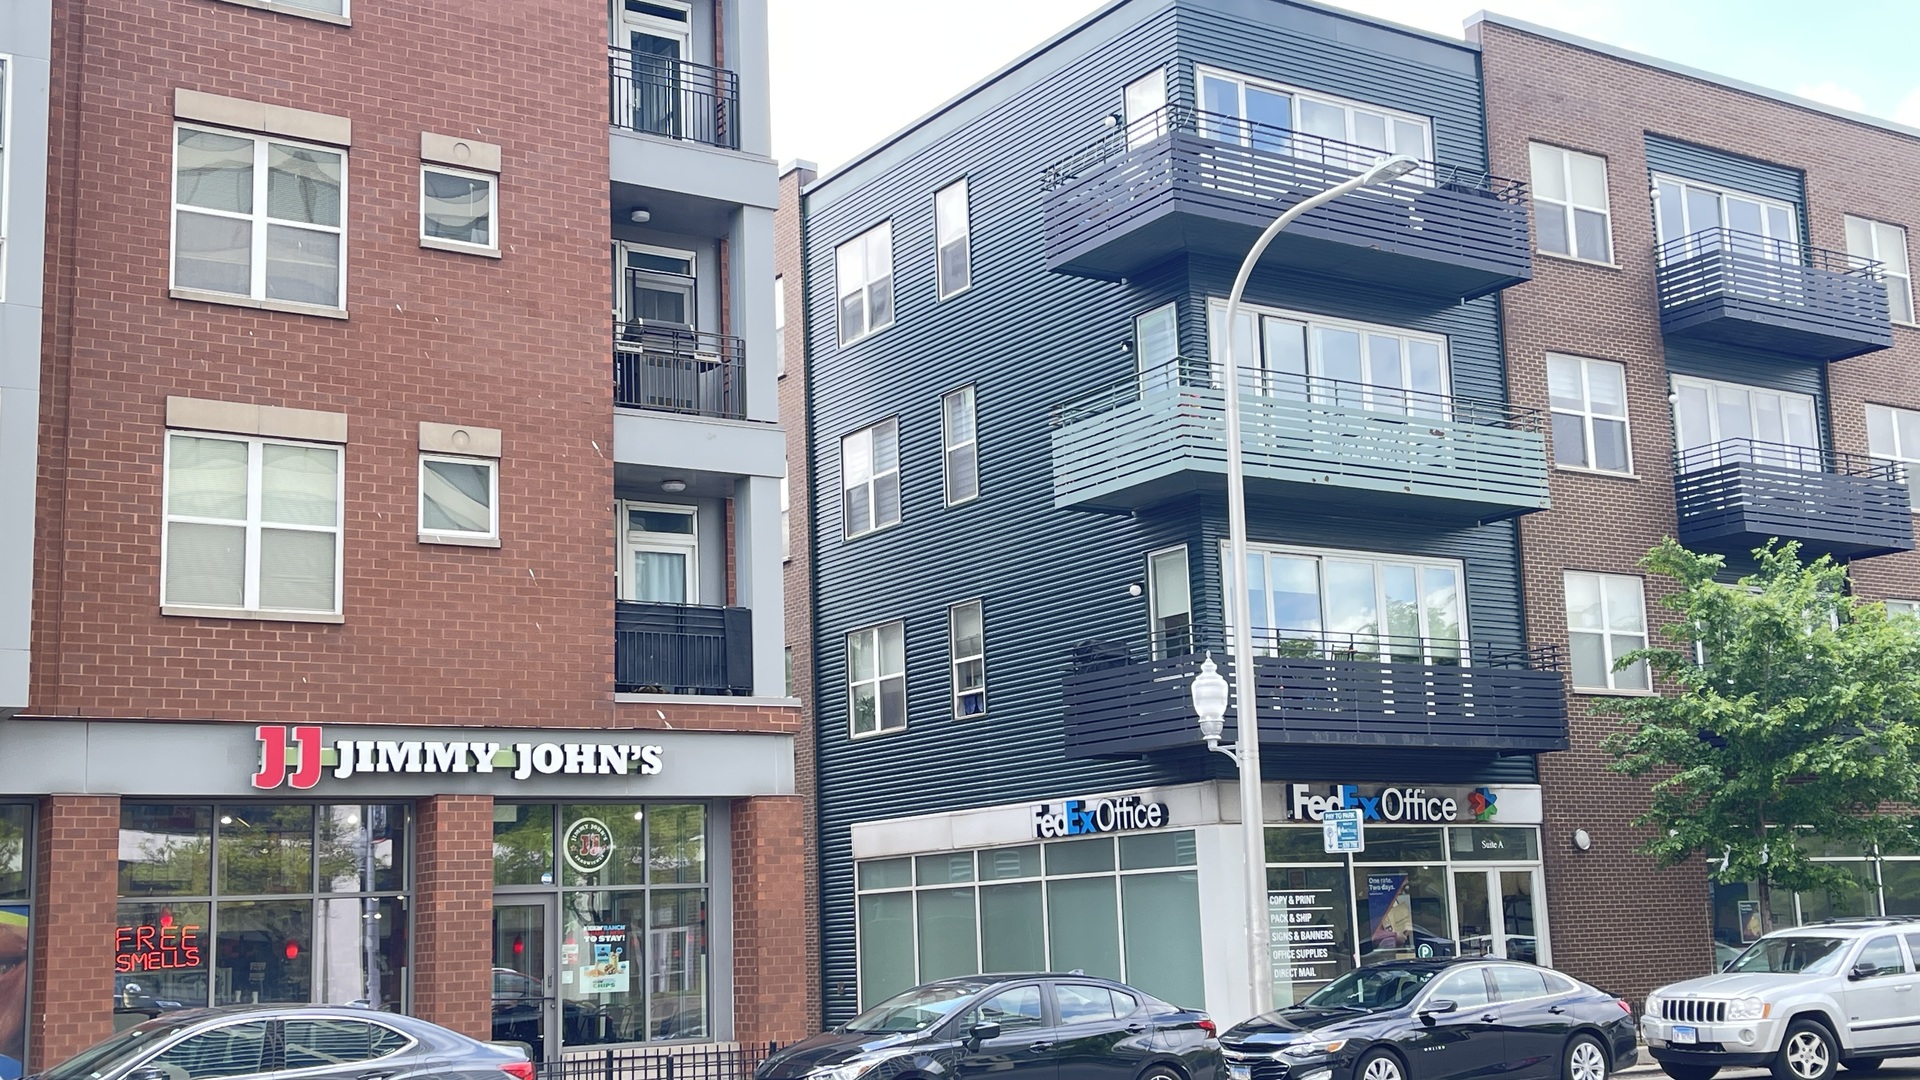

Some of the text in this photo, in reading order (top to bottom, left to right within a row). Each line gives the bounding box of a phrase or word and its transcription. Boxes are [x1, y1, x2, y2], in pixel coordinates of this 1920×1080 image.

[252, 726, 663, 789] JJ JIMMY JOHN'S
[1293, 783, 1457, 821] FedEx Office
[1031, 796, 1161, 838] FedEx Office
[1335, 812, 1342, 820] TO
[1342, 811, 1356, 819] PARK
[1481, 840, 1504, 849] Suite A
[1269, 895, 1315, 905] COPY & PRINT
[1271, 913, 1312, 923] PACK & SHIP
[115, 925, 200, 951] FREE
[1272, 930, 1333, 941] SIGNS & BANNERS
[1273, 948, 1328, 959] OFFICE SUPPLIES
[115, 949, 200, 972] SMELLS
[1274, 967, 1316, 978] DIRECT MAIL
